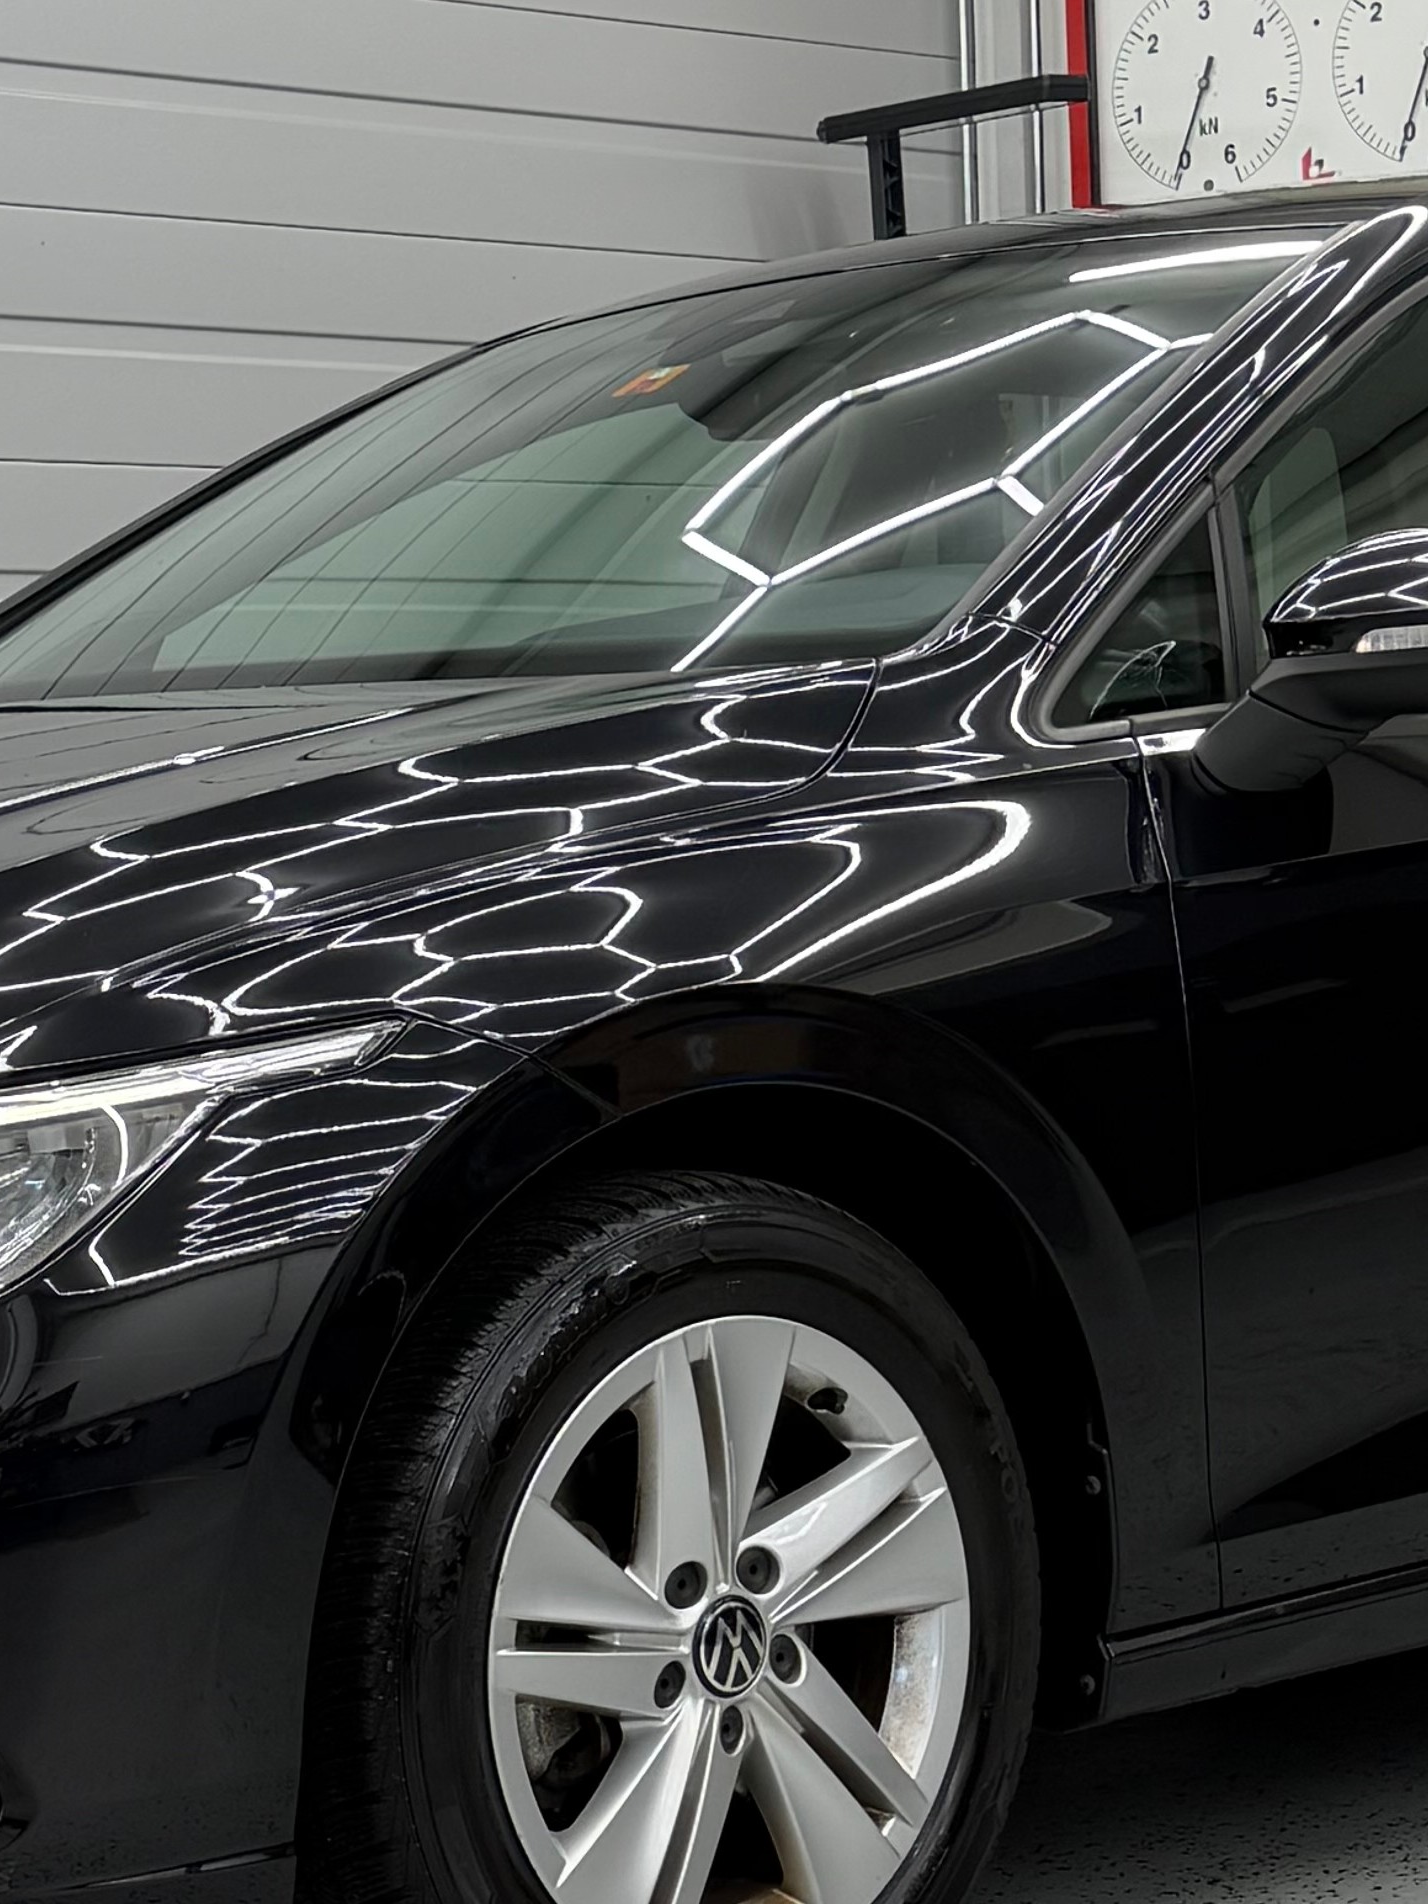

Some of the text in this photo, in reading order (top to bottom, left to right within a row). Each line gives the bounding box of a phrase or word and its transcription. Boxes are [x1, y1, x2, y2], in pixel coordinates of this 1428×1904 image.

[1198, 0, 1210, 20] 3
[1370, 2, 1382, 22] 2
[1253, 18, 1265, 37] 4
[1147, 34, 1159, 54] 2
[1355, 75, 1364, 95] 1
[1265, 87, 1277, 107] 5
[1134, 105, 1142, 124] 1
[1199, 117, 1218, 136] kN
[1403, 120, 1416, 141] 0
[1178, 150, 1191, 170] 0
[1224, 144, 1236, 164] 6
